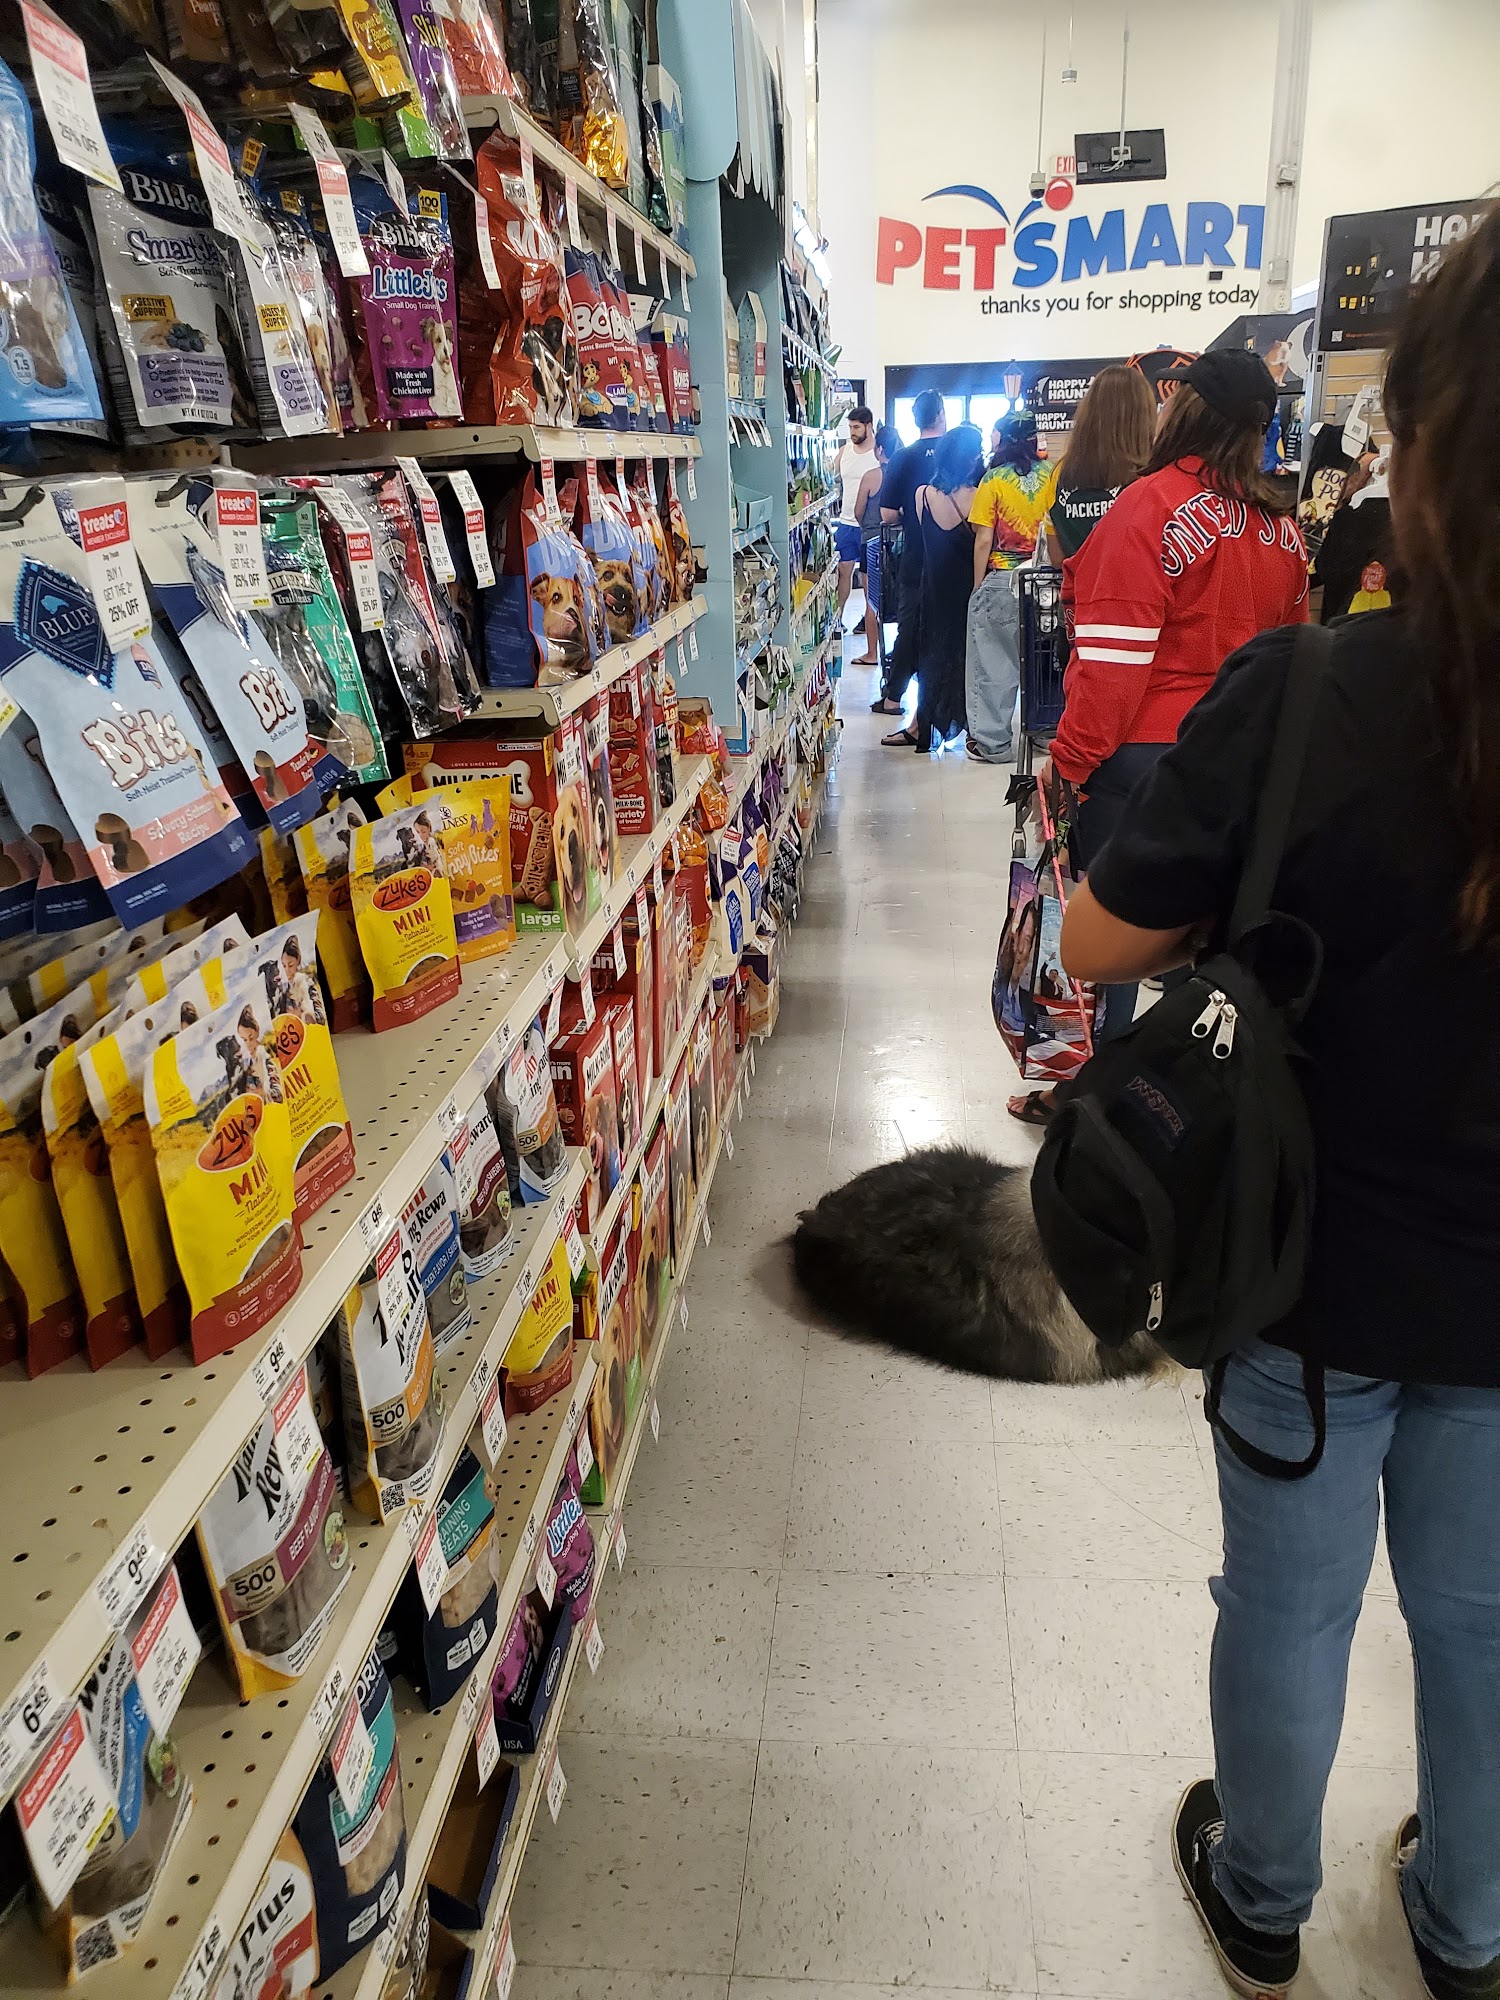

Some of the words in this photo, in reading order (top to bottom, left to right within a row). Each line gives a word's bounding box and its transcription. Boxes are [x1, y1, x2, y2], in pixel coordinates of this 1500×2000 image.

[419, 195, 439, 208] 100
[876, 202, 1266, 290] PETSMART
[404, 302, 418, 311] Dog
[980, 295, 1041, 315] thanks
[1045, 299, 1080, 318] you
[1086, 291, 1114, 312] for
[1119, 289, 1202, 314] shopping
[1208, 286, 1261, 310] today
[134, 307, 167, 317] SUPPORT
[14, 358, 30, 371] 1.5
[396, 371, 412, 380] Made
[413, 371, 428, 379] with
[405, 379, 422, 388] Fresh
[1048, 378, 1087, 390] HAPPY
[392, 387, 418, 396] Chicken
[418, 387, 432, 395] Liver
[1035, 412, 1067, 422] HAPPY
[220, 496, 246, 511] treats
[83, 512, 115, 535] treats
[234, 543, 245, 554] BUY
[230, 558, 240, 569] GET
[240, 558, 249, 569] THE
[106, 567, 119, 582] BUY
[234, 574, 249, 587] 25%
[248, 573, 260, 587] OFF
[103, 587, 114, 601] GET
[114, 583, 126, 598] THE
[109, 603, 126, 622] 25%
[126, 598, 140, 616] OFF
[39, 606, 96, 640] BLUE
[81, 708, 189, 792] Bits
[416, 752, 430, 760] LBS
[159, 769, 185, 787] Training
[177, 822, 210, 844] Recipe
[448, 841, 465, 858] Soft
[379, 874, 427, 908] Zuke's
[393, 905, 431, 935] MINI
[521, 910, 561, 926] large
[518, 1134, 538, 1147] 500
[229, 1152, 269, 1206] MINI
[238, 1275, 262, 1298] PEANUT
[531, 1275, 560, 1315] MINI
[372, 1404, 404, 1428] 500
[301, 1434, 311, 1456] OFF
[234, 1565, 276, 1597] 500
[157, 1677, 175, 1708] 25%
[173, 1648, 189, 1677] OFF
[503, 1740, 523, 1750] USA
[53, 1829, 79, 1868] 25%
[76, 1794, 96, 1831] OFF
[240, 1878, 296, 1960] Plus
